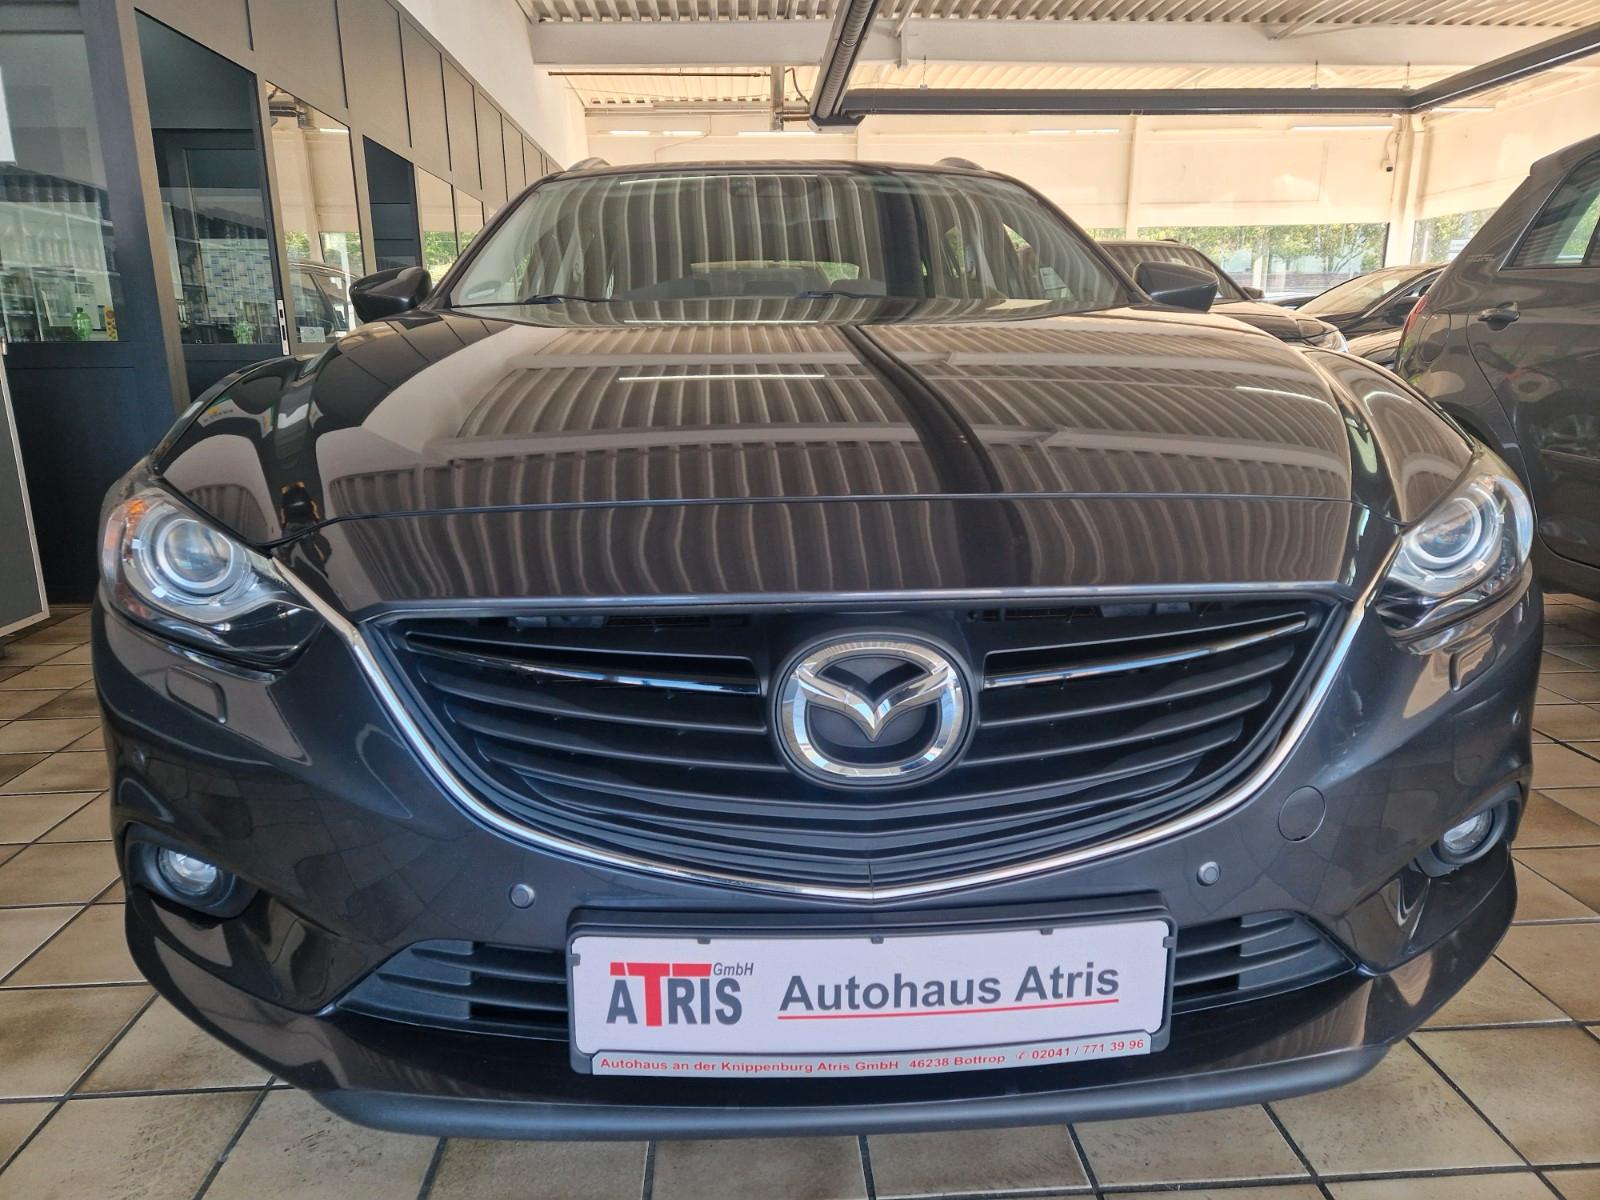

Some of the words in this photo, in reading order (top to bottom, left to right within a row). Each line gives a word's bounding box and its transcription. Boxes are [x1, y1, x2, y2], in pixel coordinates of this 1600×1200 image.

[606, 962, 742, 1027] ATRIS
[712, 962, 754, 976] GmbH
[779, 973, 1001, 1011] Autohaus
[1014, 962, 1119, 1001] Atris
[600, 1058, 668, 1070] Autohaus
[672, 1061, 689, 1071] an
[694, 1059, 716, 1071] der
[721, 1060, 813, 1074] Knippenburg
[816, 1061, 850, 1072] Atris
[855, 1060, 899, 1071] GmbH
[908, 1058, 950, 1069] 46238
[953, 1053, 1006, 1066] Bottrop
[1031, 1047, 1070, 1060] 02041
[1083, 1044, 1105, 1055] 771
[1110, 1042, 1125, 1052] 39
[1129, 1039, 1144, 1050] 96
